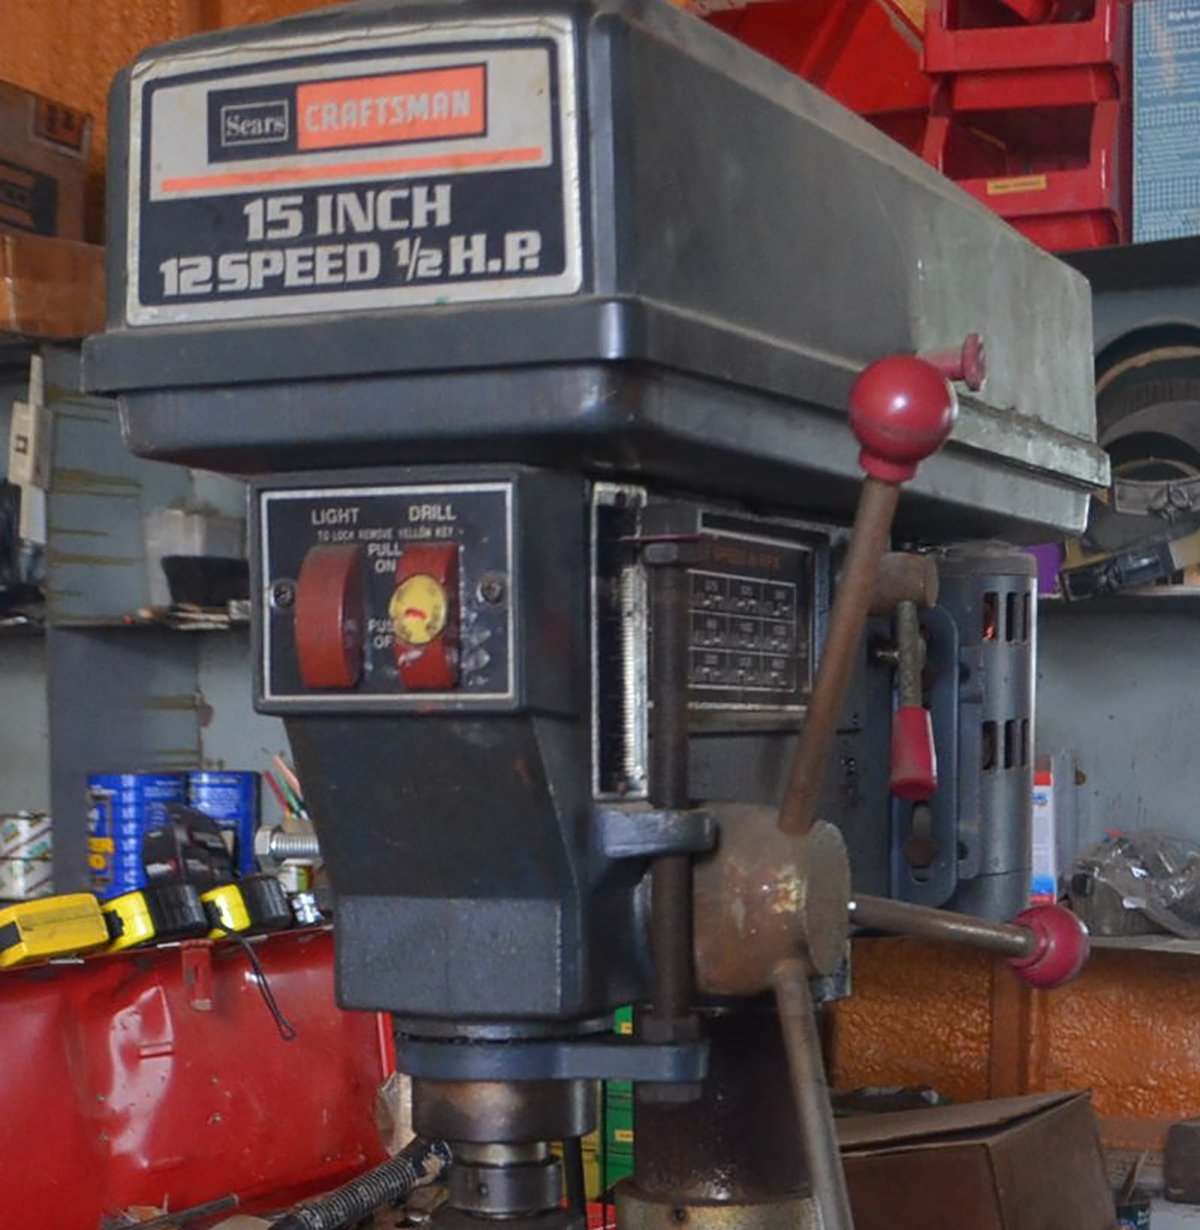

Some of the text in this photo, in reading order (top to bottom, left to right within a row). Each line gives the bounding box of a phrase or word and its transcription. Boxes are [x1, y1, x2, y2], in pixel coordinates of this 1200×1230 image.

[305, 90, 472, 132] CRAFTSMAN
[226, 107, 287, 138] Sears
[243, 185, 452, 241] 15 INCH
[159, 256, 212, 297] 12
[218, 243, 380, 292] SPEED
[312, 505, 456, 525] LIGHT DRILL
[332, 530, 354, 541] LOCK
[368, 543, 403, 557] PULL
[375, 560, 396, 572] ON
[368, 619, 395, 632] PUS
